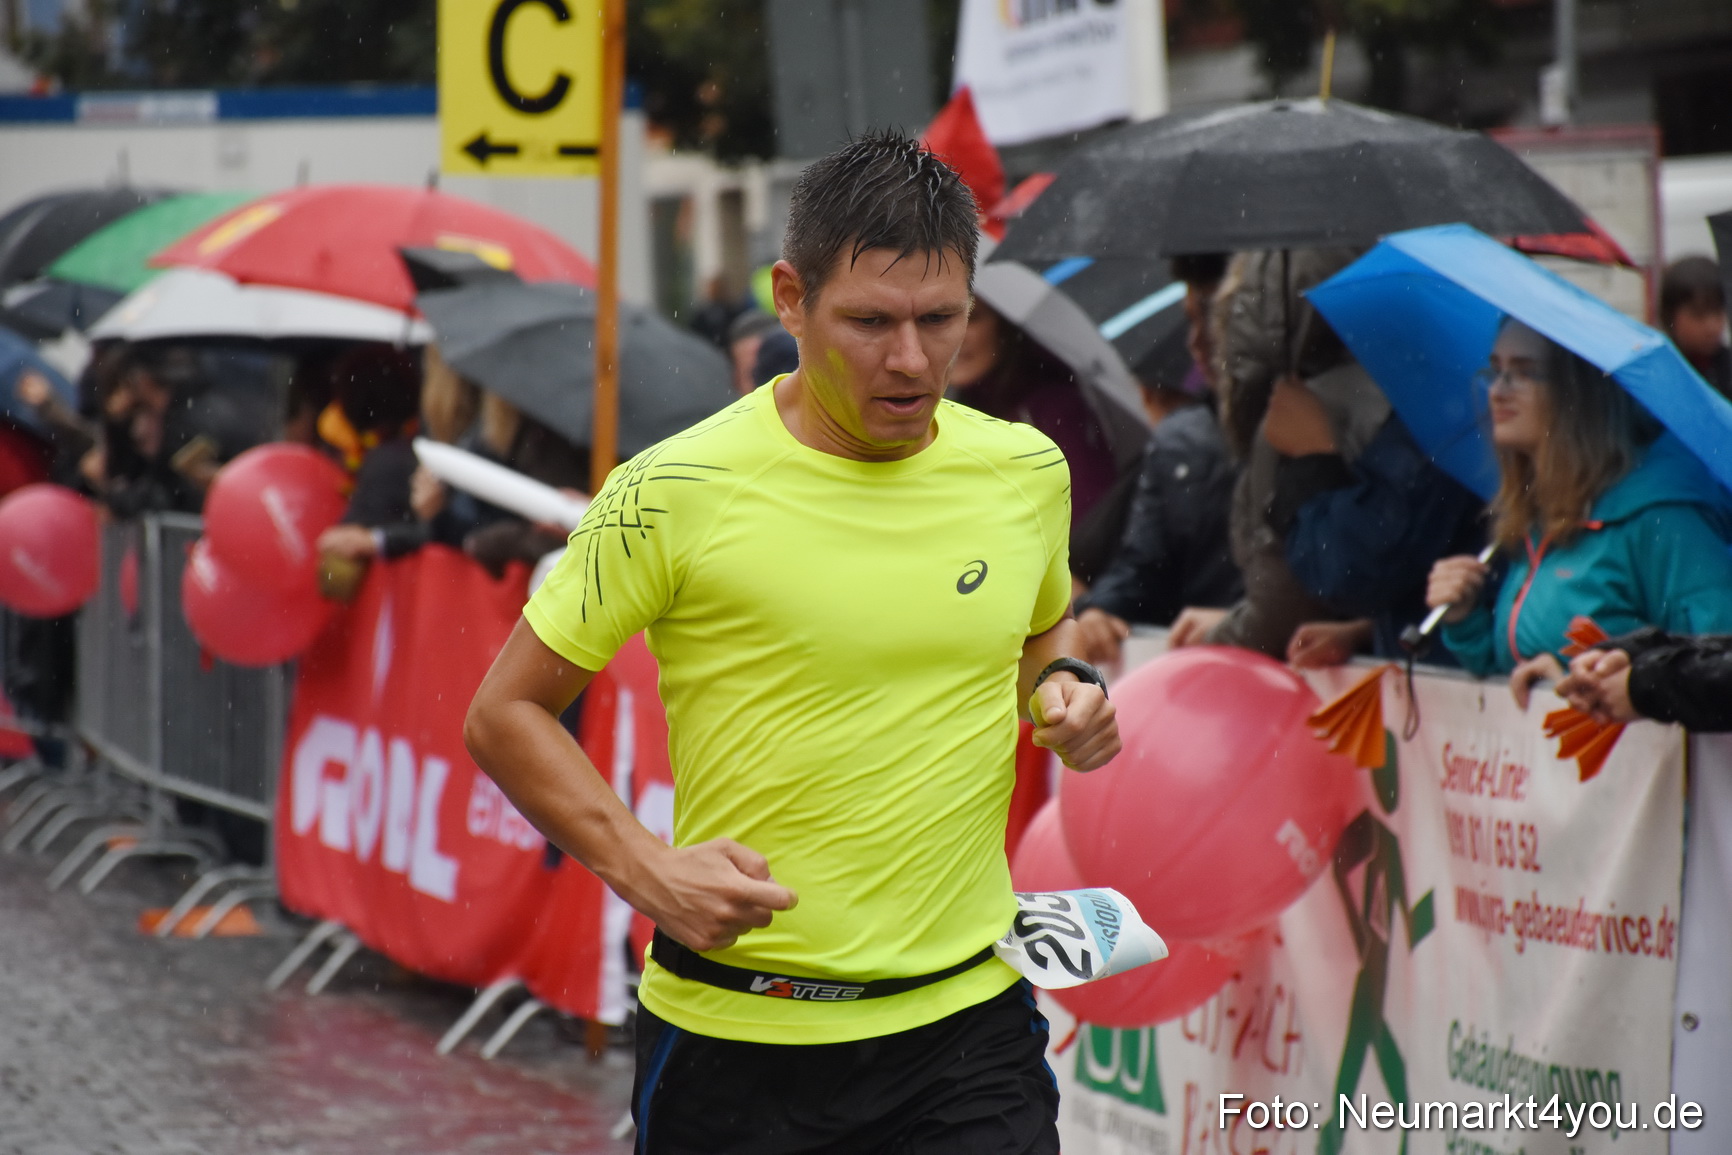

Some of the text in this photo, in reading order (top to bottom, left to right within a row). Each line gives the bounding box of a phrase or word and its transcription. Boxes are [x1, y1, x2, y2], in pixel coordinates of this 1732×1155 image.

[488, 0, 572, 114] C
[1518, 822, 1542, 873] 52
[750, 975, 865, 1001] V3TEC
